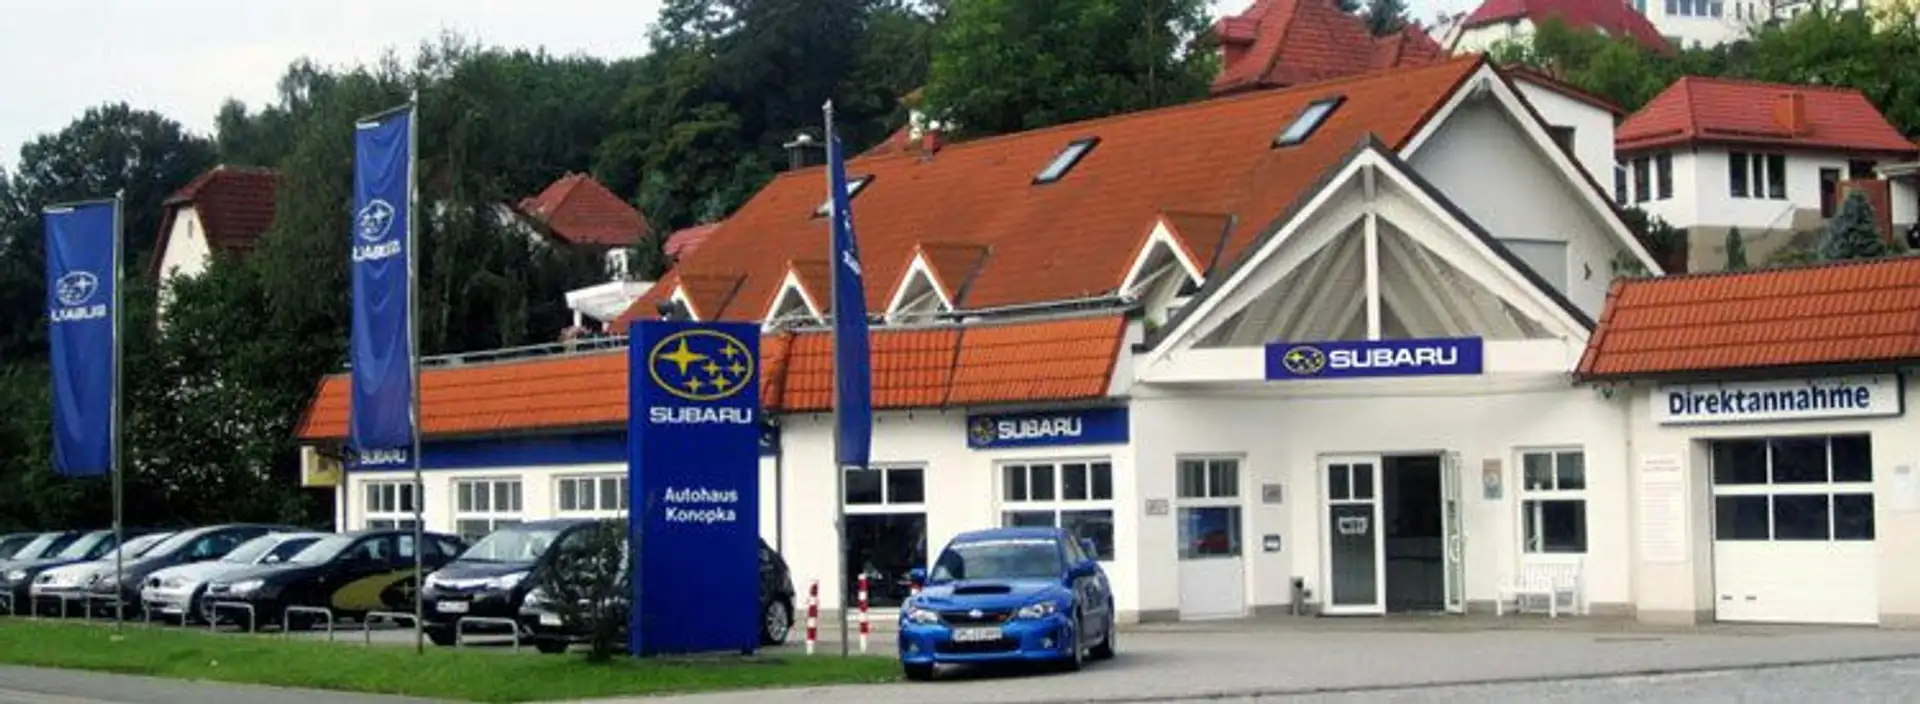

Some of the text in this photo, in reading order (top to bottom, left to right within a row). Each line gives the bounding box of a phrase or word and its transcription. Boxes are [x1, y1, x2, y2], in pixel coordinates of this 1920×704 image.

[1328, 345, 1458, 369] SUBARU
[1668, 383, 1870, 416] Direktannahme
[649, 406, 753, 424] SUBARU
[998, 416, 1082, 440] SUBARU
[360, 449, 407, 465] SUBARU
[664, 486, 739, 503] Autohaus
[665, 506, 737, 524] Konopka
